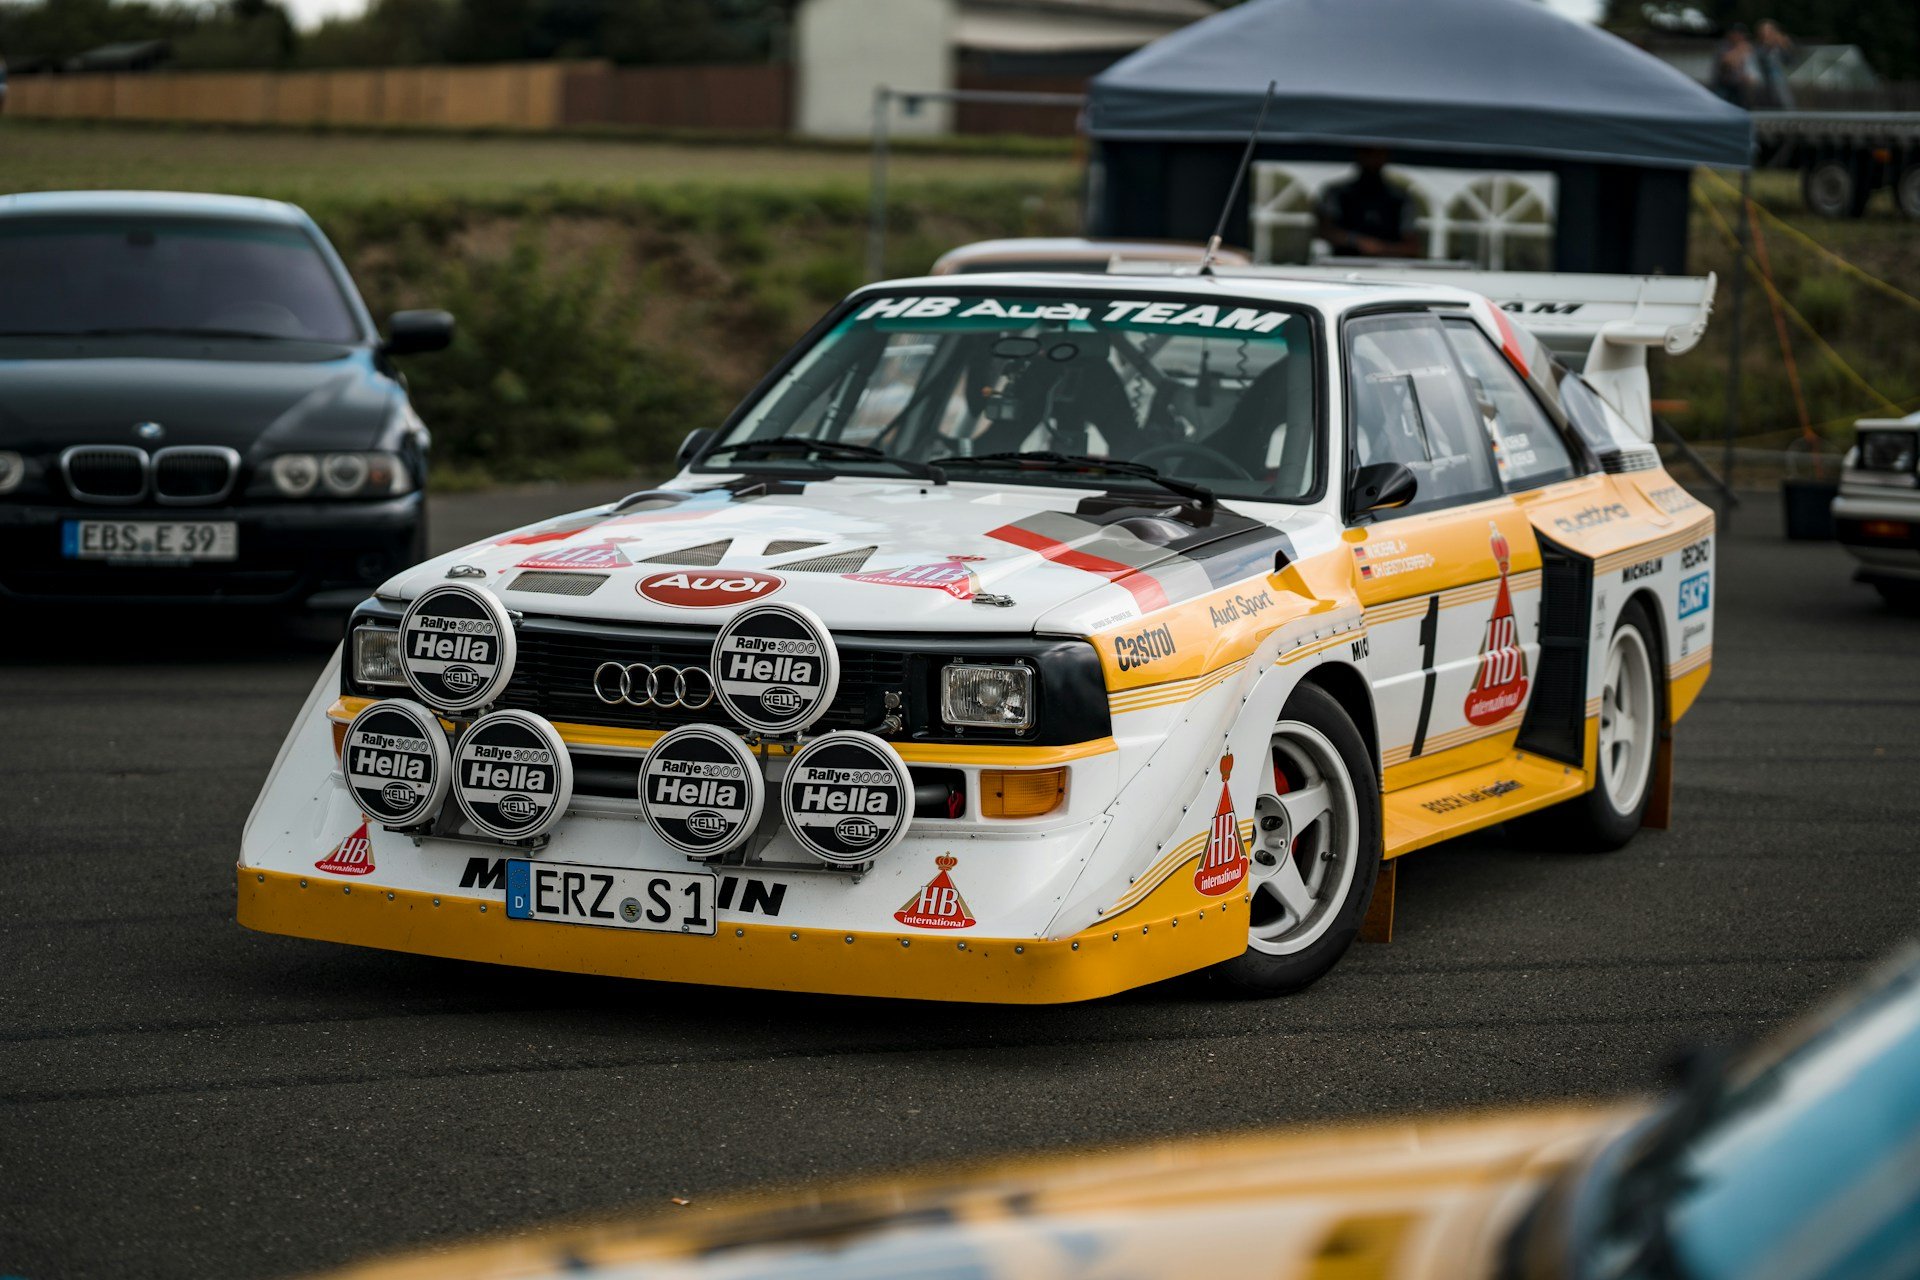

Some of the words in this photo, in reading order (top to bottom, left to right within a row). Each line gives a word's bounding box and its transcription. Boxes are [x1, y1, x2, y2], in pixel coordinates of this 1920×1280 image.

[855, 297, 961, 320] HB
[957, 299, 1091, 320] Audi
[1101, 300, 1292, 333] TEAM
[83, 524, 138, 551] EBS
[157, 525, 174, 552] E
[182, 525, 215, 552] 39
[649, 573, 769, 593] Audi
[888, 565, 973, 581] HB
[1623, 557, 1663, 583] MICHELIN
[857, 575, 969, 599] international
[1680, 577, 1706, 615] SKF
[1209, 601, 1240, 628] Audi
[1237, 590, 1274, 617] Sport
[420, 617, 456, 631] Rallye
[457, 620, 493, 634] 3000
[414, 633, 489, 661] Hella
[736, 637, 776, 652] Rallye
[777, 641, 816, 654] 3000
[1114, 623, 1176, 672] Castrol
[1483, 615, 1519, 690] HB
[445, 671, 480, 685] HELLA
[728, 654, 812, 683] Hella
[1409, 595, 1439, 757] 1
[764, 694, 801, 708] HELLA
[1470, 688, 1520, 717] international
[362, 733, 395, 748] Rallye
[395, 739, 428, 752] 3000
[475, 746, 512, 760] Rallye
[513, 750, 550, 763] 3000
[356, 749, 425, 780] Hella
[469, 763, 546, 791] Hella
[662, 760, 702, 776] Rallye
[702, 764, 741, 778] 3000
[808, 768, 850, 784] Rallye
[851, 771, 892, 784] 3000
[385, 789, 416, 803] HELLA
[655, 777, 737, 807] Hella
[801, 786, 889, 813] Hella
[502, 801, 537, 815] HELLA
[690, 818, 727, 832] HELLA
[838, 825, 878, 839] HELLA
[334, 837, 371, 864] HB
[1210, 811, 1236, 869] HB
[320, 862, 367, 875] international
[1201, 863, 1242, 890] international
[515, 896, 523, 908] D
[536, 869, 614, 919] ERZ
[917, 886, 960, 916] HB
[904, 915, 965, 927] international
